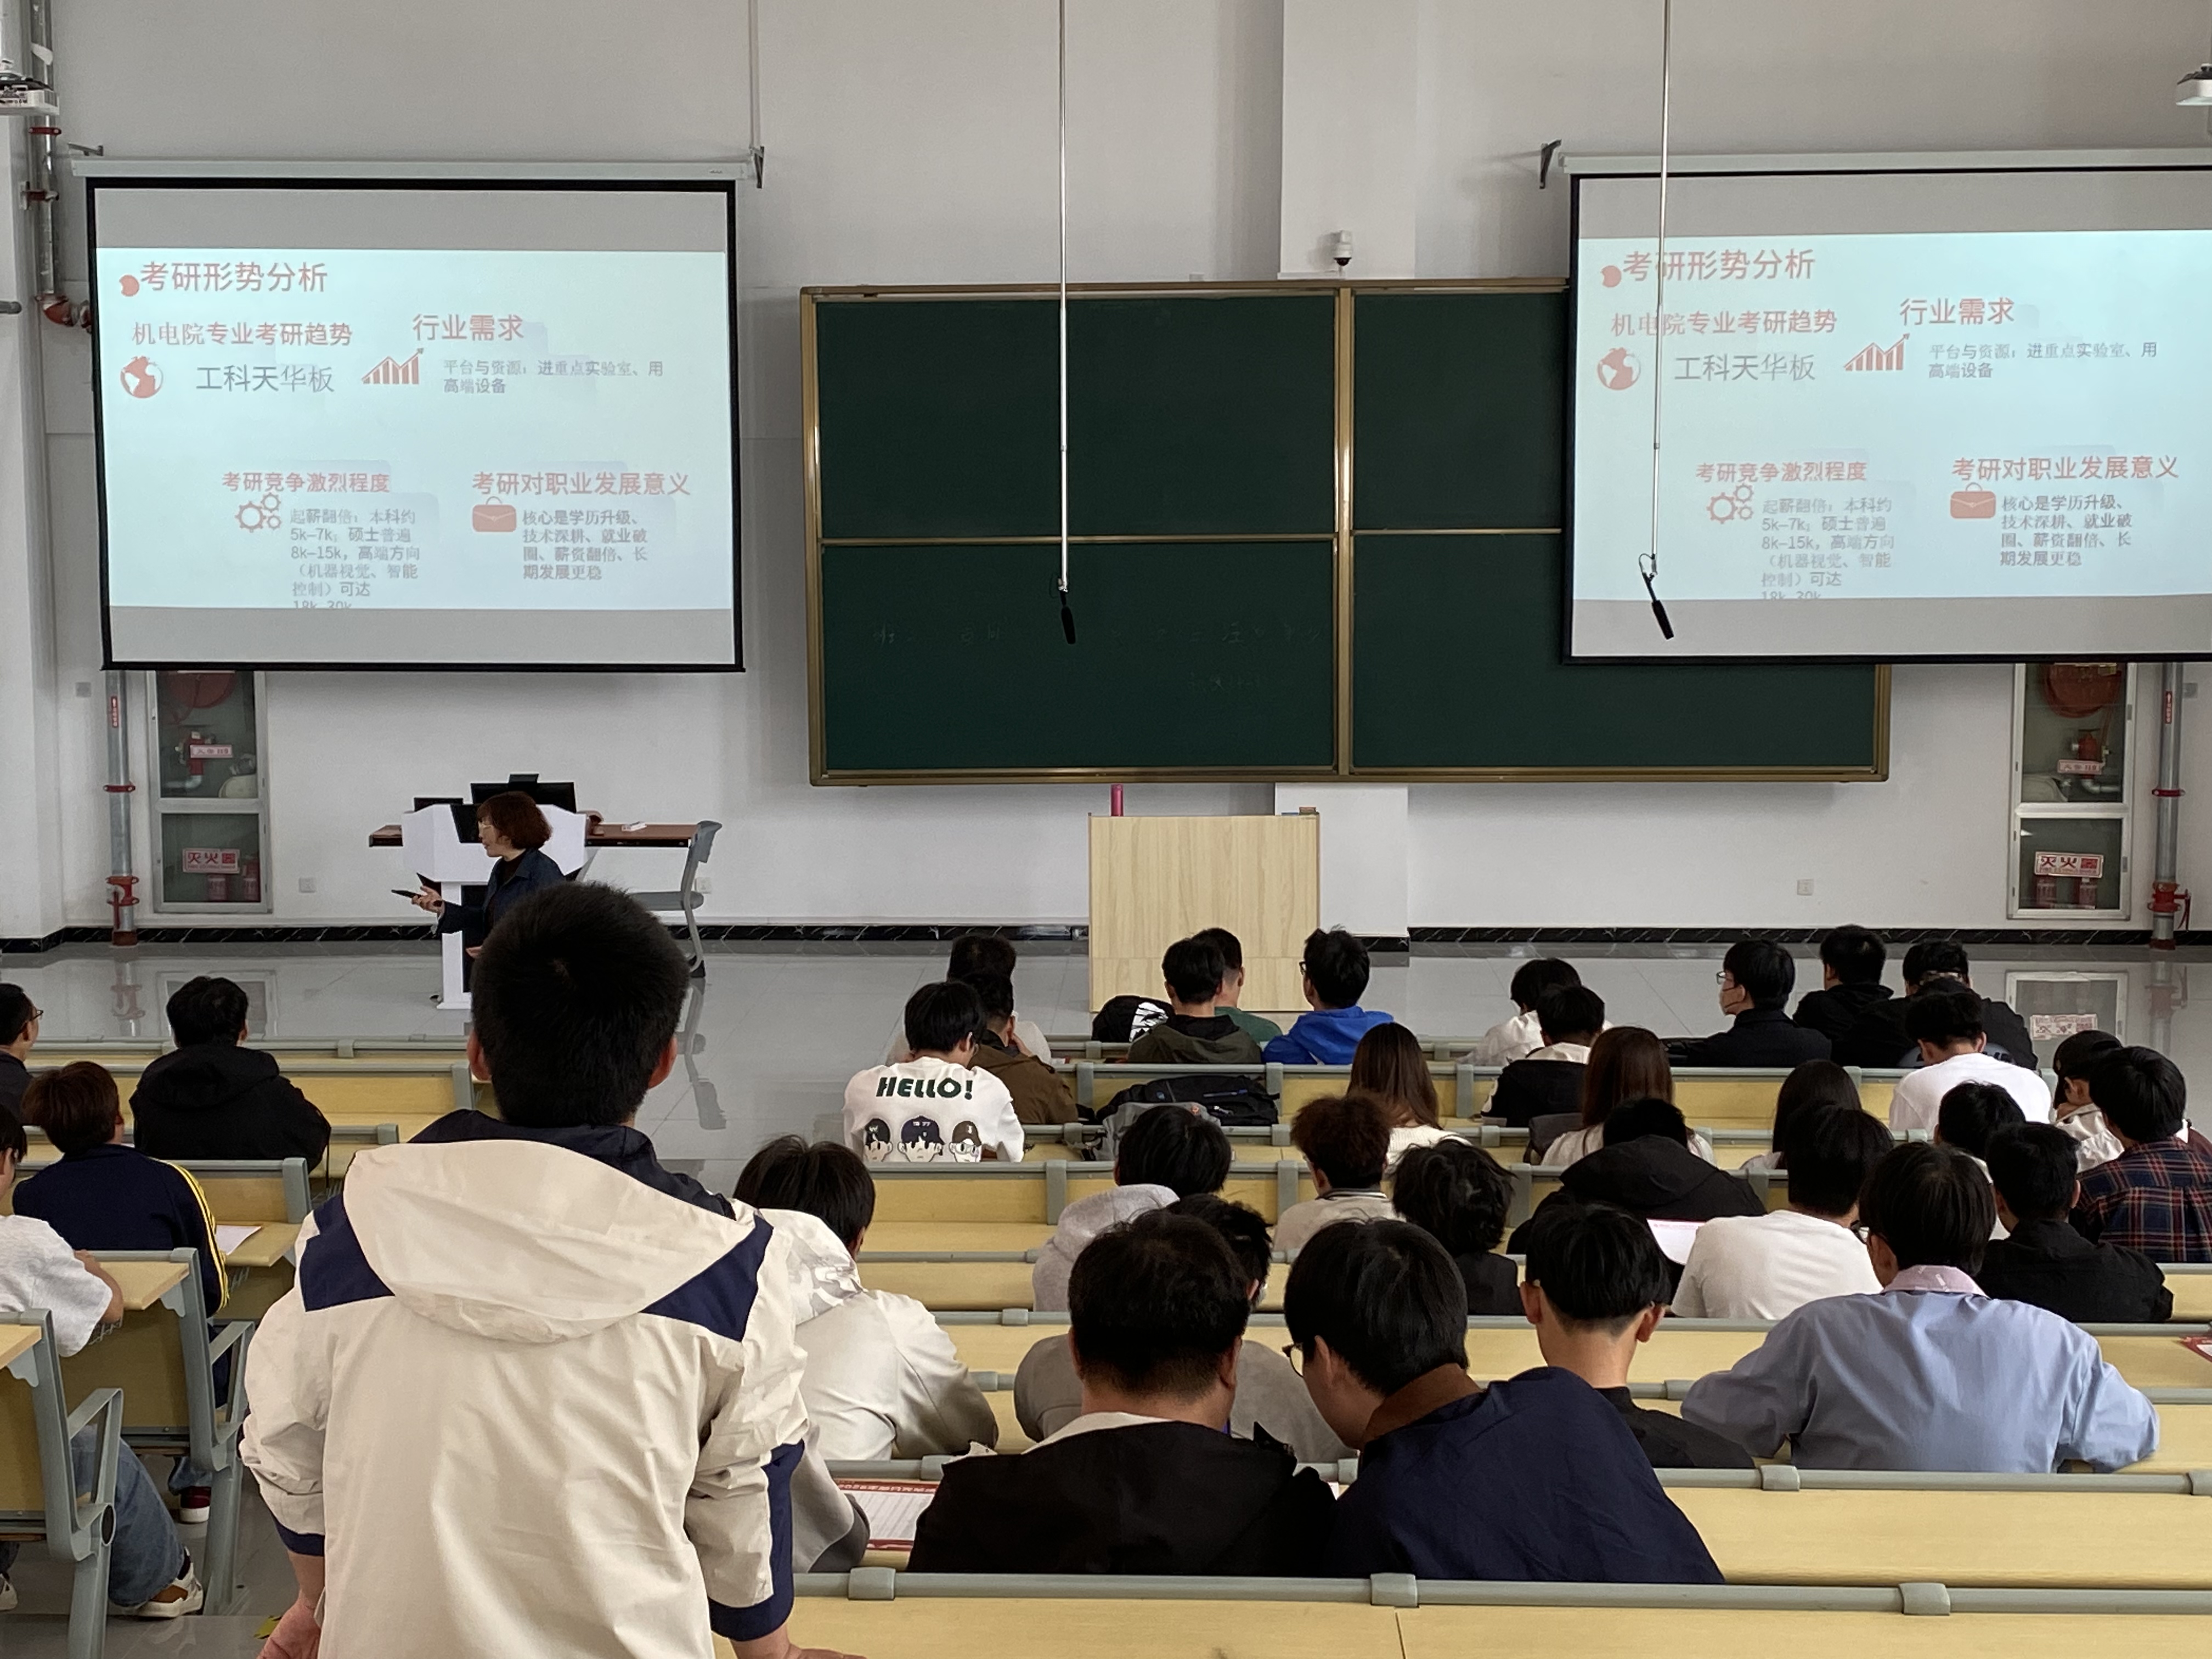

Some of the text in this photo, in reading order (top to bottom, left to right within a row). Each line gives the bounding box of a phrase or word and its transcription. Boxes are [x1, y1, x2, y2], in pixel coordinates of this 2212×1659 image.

[140, 262, 328, 292] 考研形势分析
[1623, 249, 1816, 281] 考研形势分析
[1611, 308, 1837, 336] 机电院专业考研趋势
[1899, 297, 2015, 326] 行业需求
[132, 321, 353, 346] 机电院专业考研趋势
[413, 314, 524, 341] 行业需求
[1929, 362, 1993, 379] 高端设备
[444, 377, 506, 393] 高端设备
[1696, 461, 1867, 483] 考研竞争激烈程度
[1951, 455, 2179, 481] 考研对职业发展意义
[222, 471, 390, 493] 考研竞争激烈程度
[472, 471, 690, 495] 考研对职业发展意义
[523, 564, 602, 580] 期发展更稳
[876, 1077, 973, 1100] HELLO!
